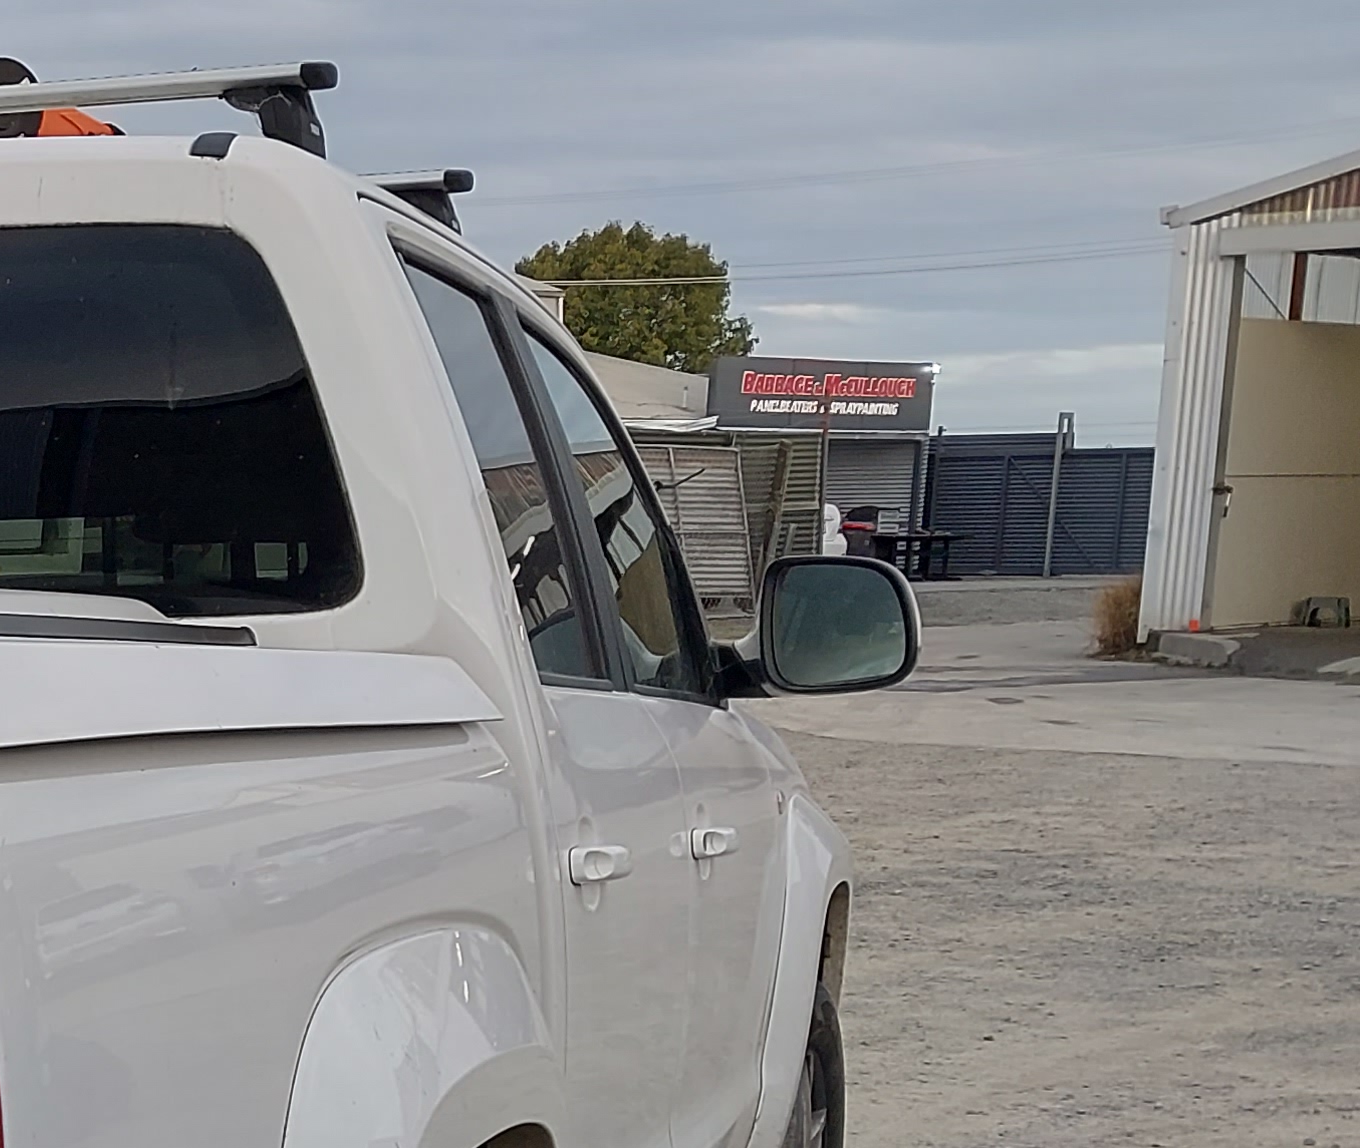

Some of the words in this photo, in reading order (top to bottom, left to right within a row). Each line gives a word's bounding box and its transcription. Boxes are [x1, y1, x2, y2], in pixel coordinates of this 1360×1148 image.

[741, 370, 814, 396] BABBAGE
[824, 373, 916, 398] McCULLOUGH
[829, 401, 899, 415] SPRAYPAINTING
